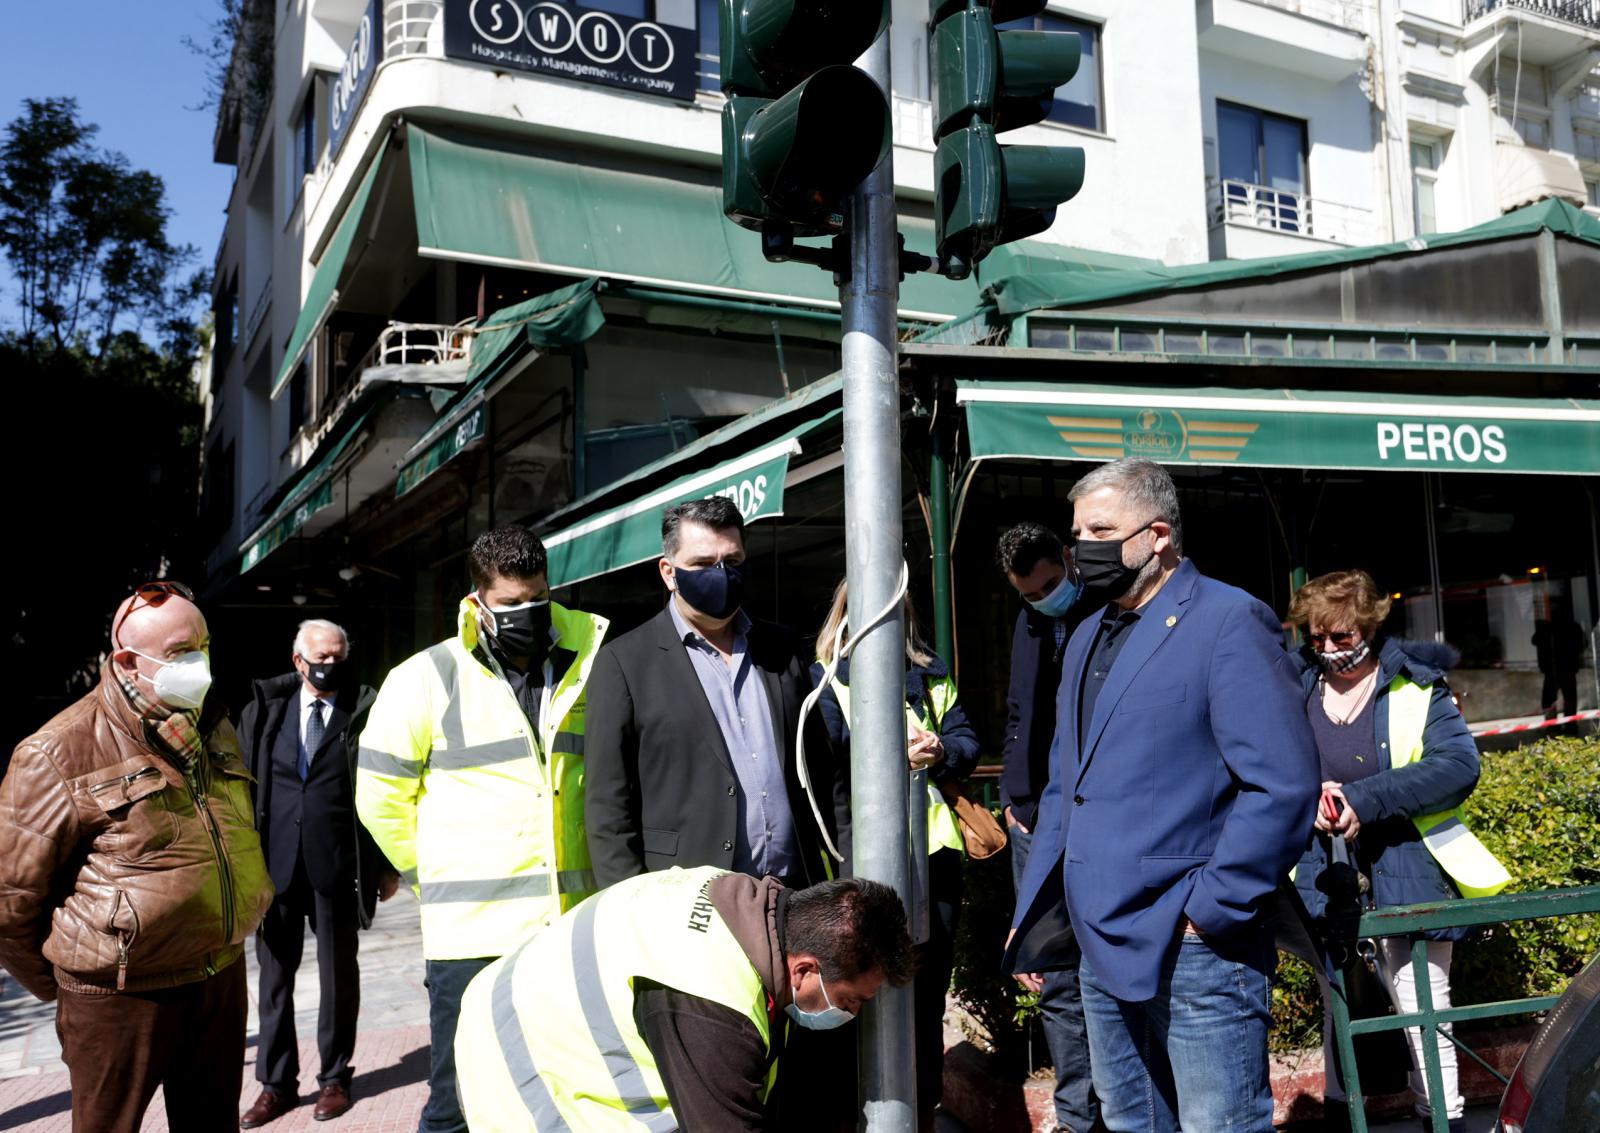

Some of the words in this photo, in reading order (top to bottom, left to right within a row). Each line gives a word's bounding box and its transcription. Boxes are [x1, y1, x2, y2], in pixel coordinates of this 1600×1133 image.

[489, 3, 658, 62] SWOT
[541, 56, 619, 81] Management
[1377, 422, 1507, 463] PEROS
